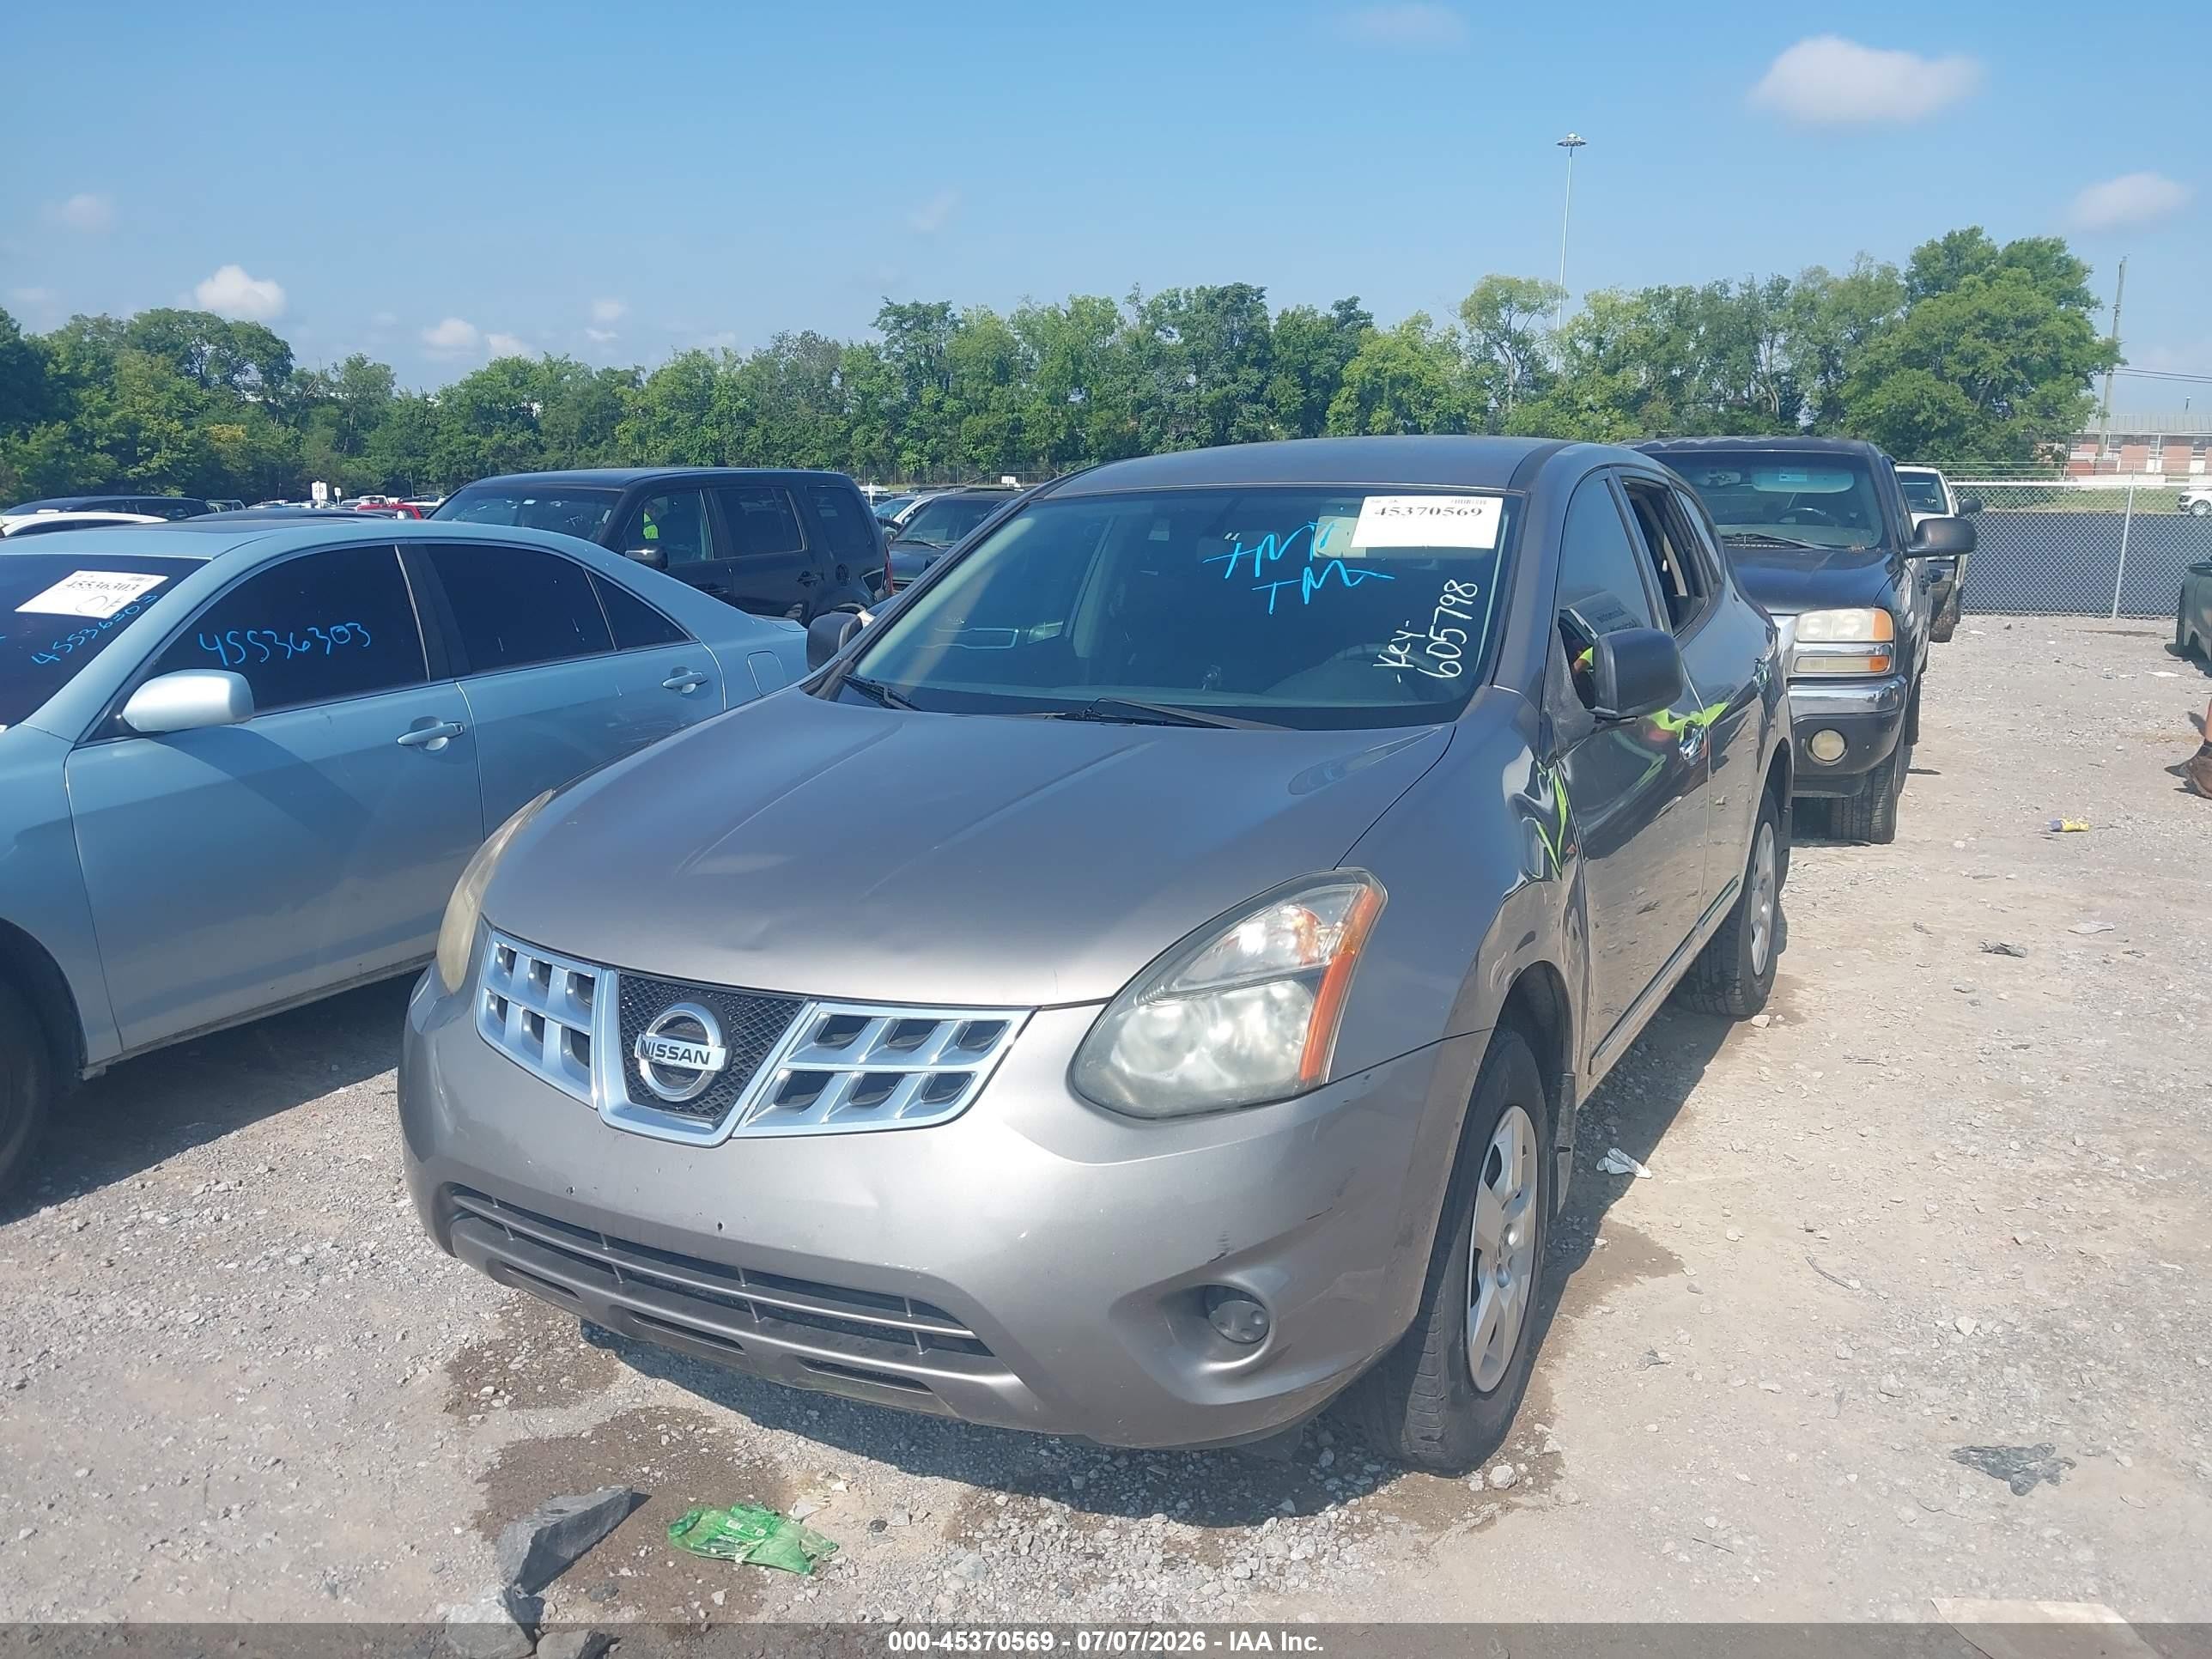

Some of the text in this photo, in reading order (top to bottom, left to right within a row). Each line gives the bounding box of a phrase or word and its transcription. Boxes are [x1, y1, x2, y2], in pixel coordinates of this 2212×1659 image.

[1374, 507, 1484, 517] 45370569
[65, 580, 141, 592] 45536303
[31, 593, 158, 665] 45536303
[198, 621, 372, 666] 45536303
[1417, 579, 1479, 678] 605798
[639, 1039, 711, 1066] NISSAN
